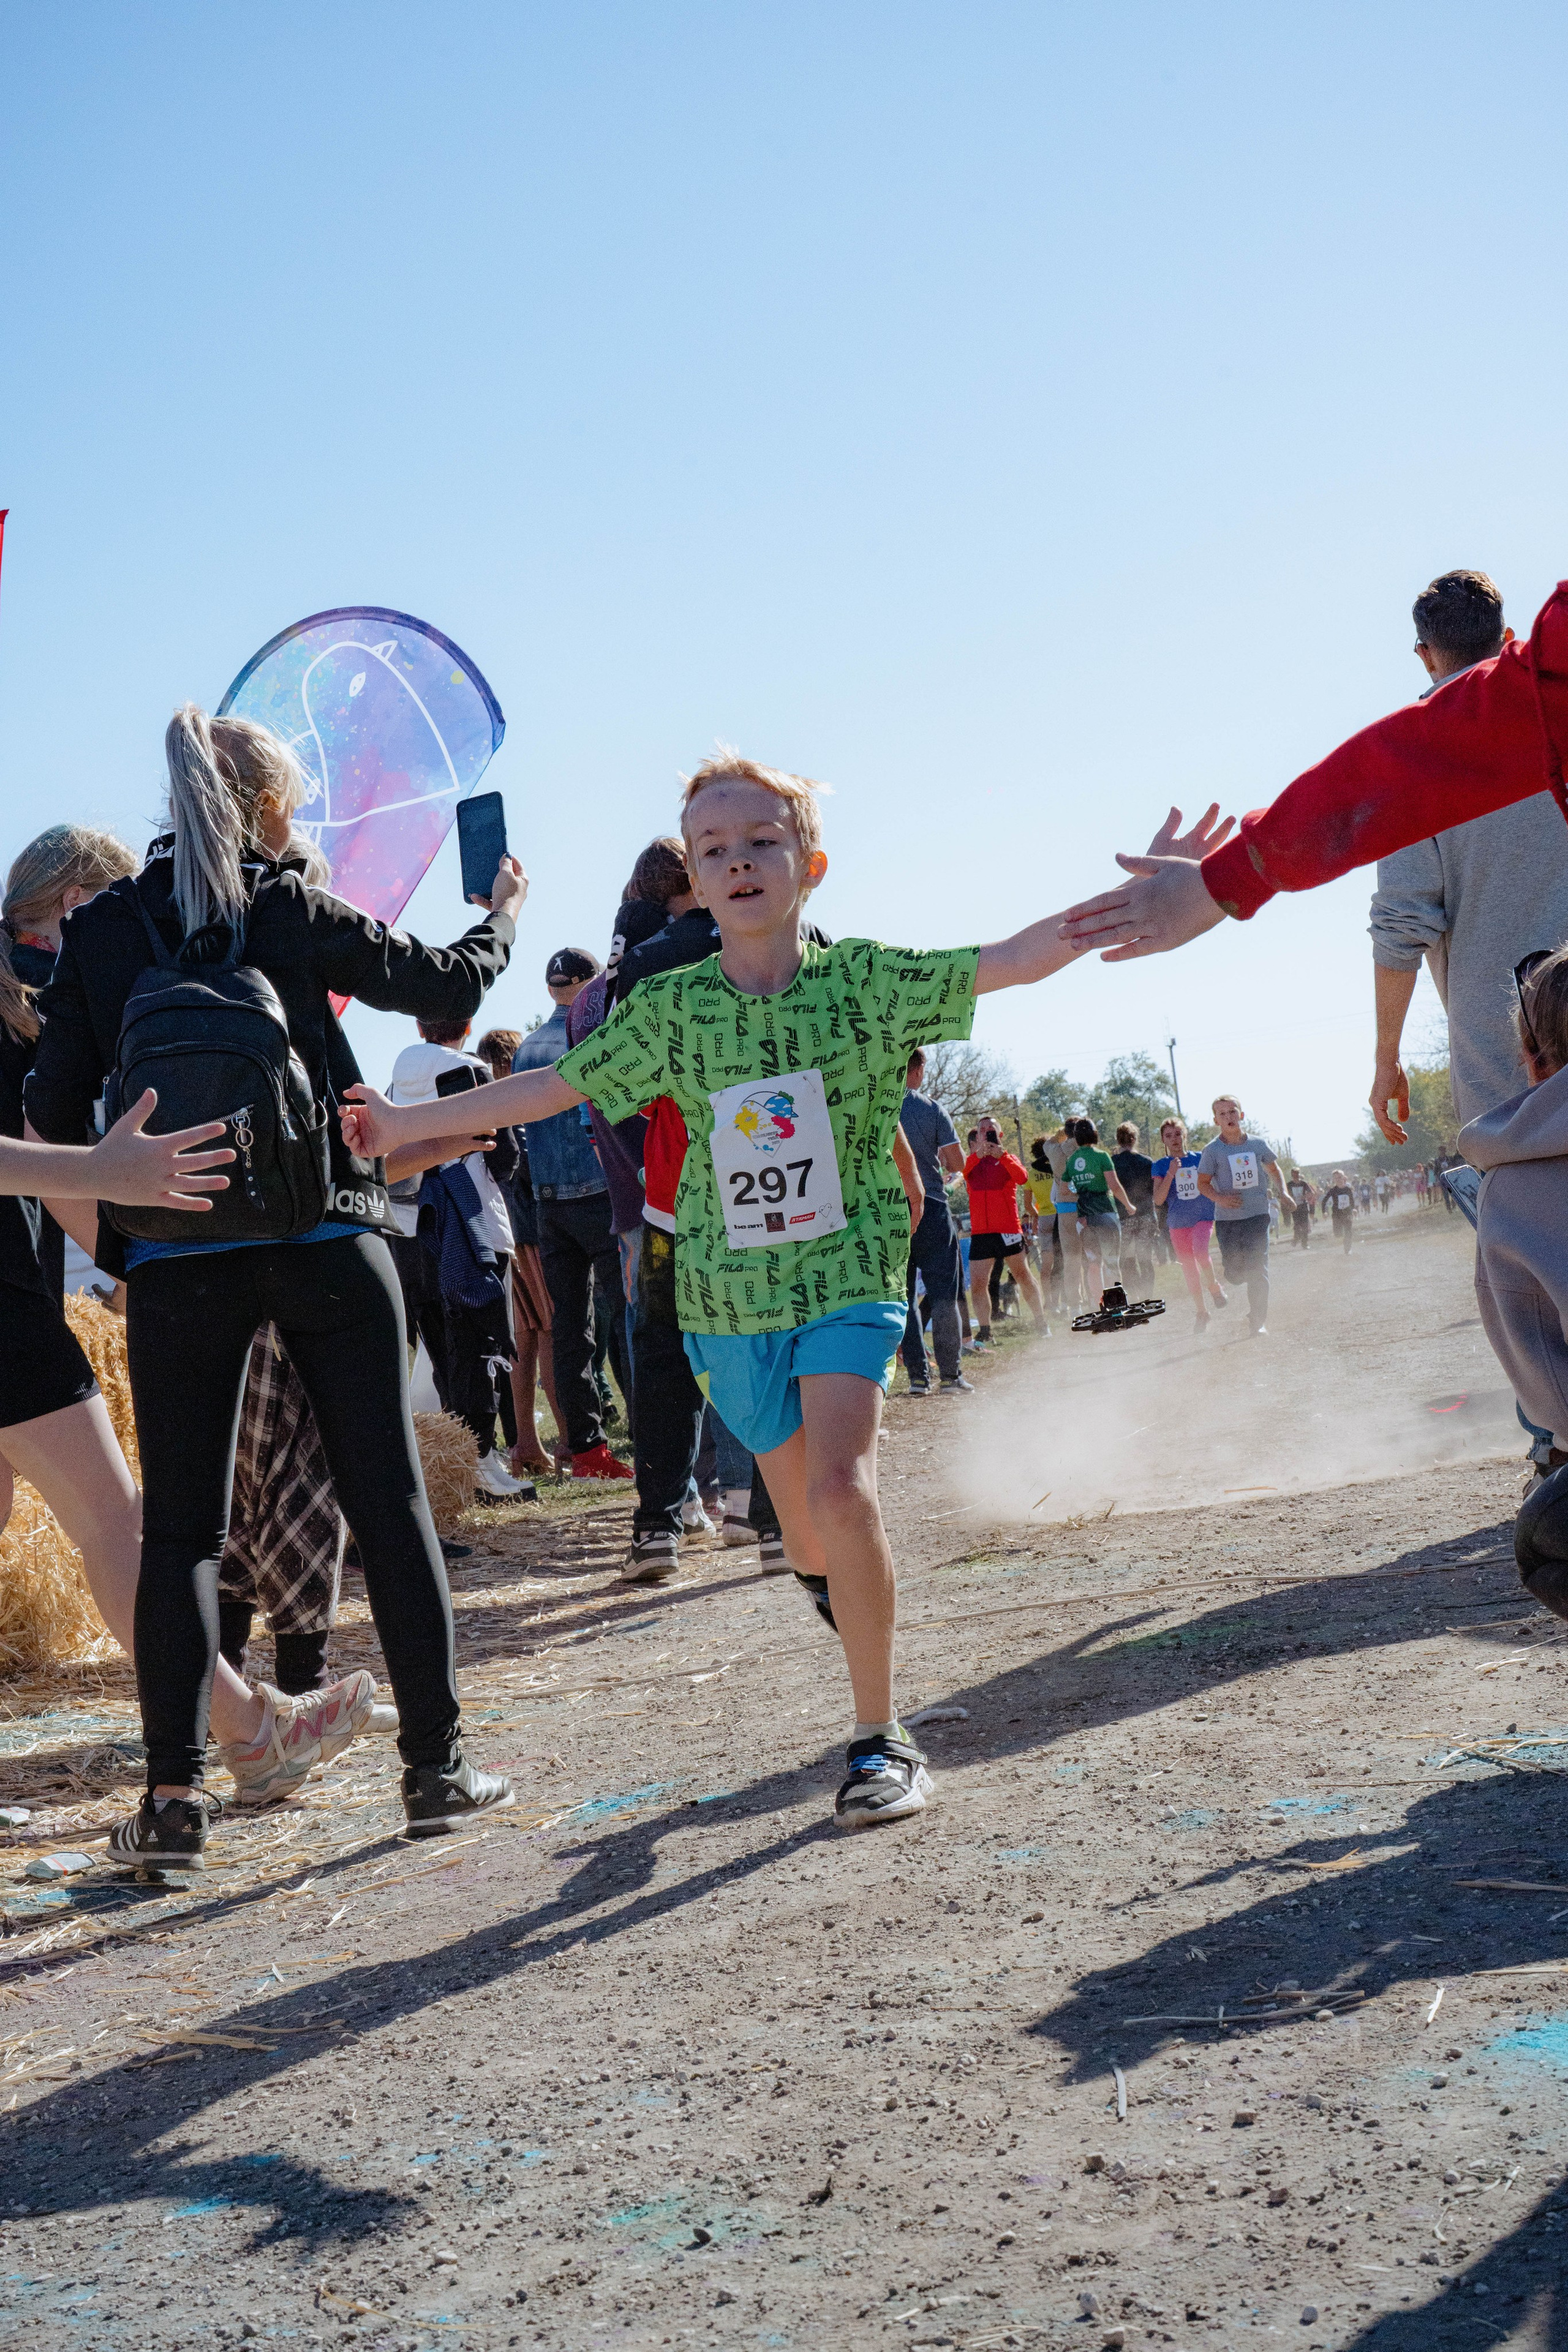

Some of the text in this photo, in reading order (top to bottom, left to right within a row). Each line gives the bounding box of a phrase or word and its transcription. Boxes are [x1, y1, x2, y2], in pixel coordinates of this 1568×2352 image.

[927, 951, 951, 960] PRO
[882, 964, 936, 982] FILA PRO
[957, 971, 970, 995] PRO
[673, 981, 684, 1011] FILA
[699, 997, 721, 1008] PRO
[907, 995, 932, 1006] PRO
[939, 978, 952, 1005] FILA
[690, 1014, 716, 1025] FILA
[792, 1004, 817, 1015] FILA
[825, 987, 846, 1039] FILA PRO
[764, 1012, 776, 1037] PRO
[843, 996, 873, 1046] FILA
[858, 1046, 869, 1072] PRO
[902, 1012, 941, 1035] FILA
[626, 1025, 657, 1061] FILA PRO
[714, 1033, 724, 1058] PRO
[783, 1025, 802, 1067] FILA
[809, 1023, 821, 1047] PRO
[579, 1041, 628, 1082] FILA PRO
[619, 1057, 643, 1076] PRO
[668, 1019, 690, 1098] FILA PRO
[810, 1049, 850, 1068] FILA PRO
[692, 1052, 711, 1091] FILA
[724, 1064, 753, 1076] FILA
[822, 1066, 845, 1082] PRO
[600, 1088, 618, 1109] PRO
[843, 1087, 865, 1102] PRO
[684, 1109, 700, 1118] PRO
[729, 1158, 813, 1206] 297
[1178, 1182, 1195, 1192] 300
[1235, 1170, 1253, 1182] 318
[877, 1187, 907, 1205] FIL
[888, 1212, 908, 1221] PRO
[889, 1229, 908, 1240] FILA
[704, 1234, 714, 1262] FILA
[820, 1241, 845, 1259] FILA
[854, 1240, 875, 1277] FILA
[717, 1263, 744, 1273] FILA
[766, 1250, 781, 1303] FILA PRO
[795, 1260, 805, 1283] PRO
[837, 1260, 849, 1284] PRO
[723, 1281, 733, 1299] PRO
[745, 1281, 756, 1305] PRO
[812, 1269, 830, 1303] FILA
[838, 1286, 867, 1301] FILA
[695, 1267, 719, 1335] FILA PR
[756, 1306, 784, 1320] FILA
